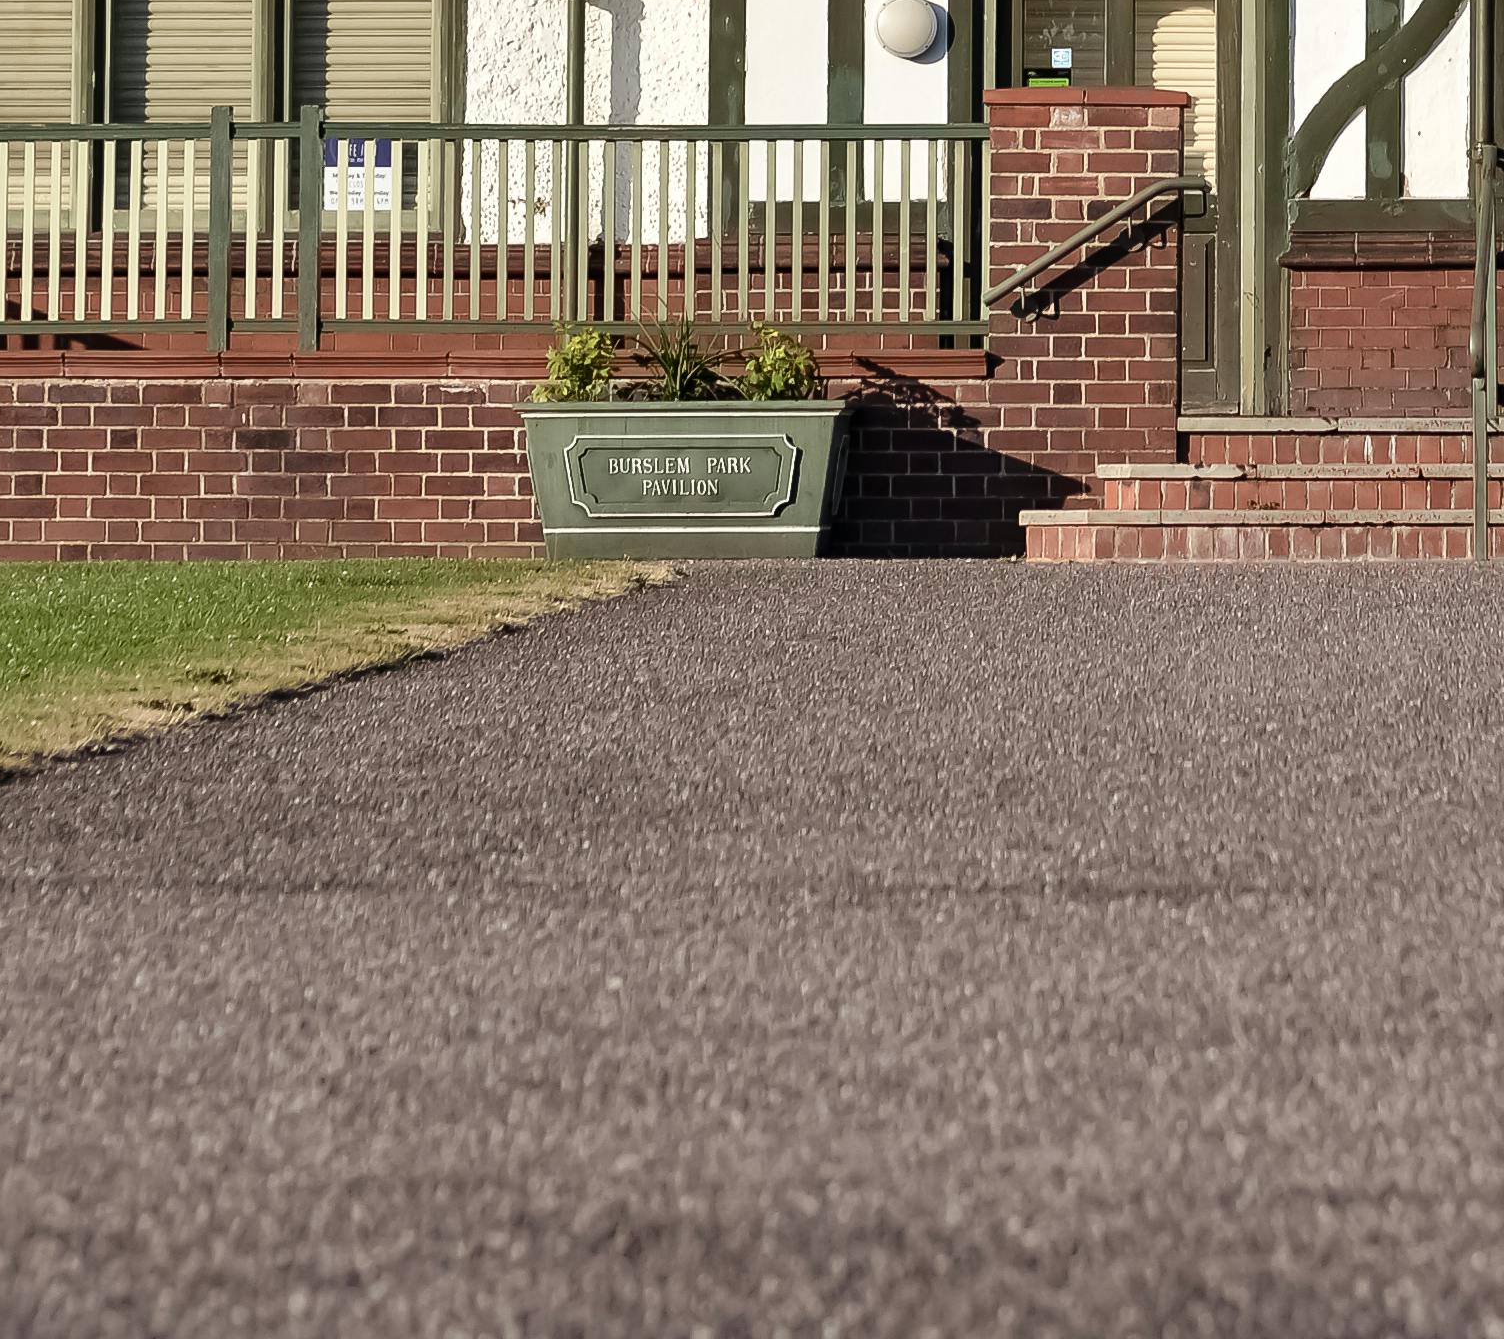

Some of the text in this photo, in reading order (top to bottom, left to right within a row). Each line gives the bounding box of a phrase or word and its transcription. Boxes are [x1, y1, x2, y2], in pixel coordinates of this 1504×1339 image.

[608, 456, 751, 475] BURSLEM PARK
[642, 479, 719, 496] PAVILION
